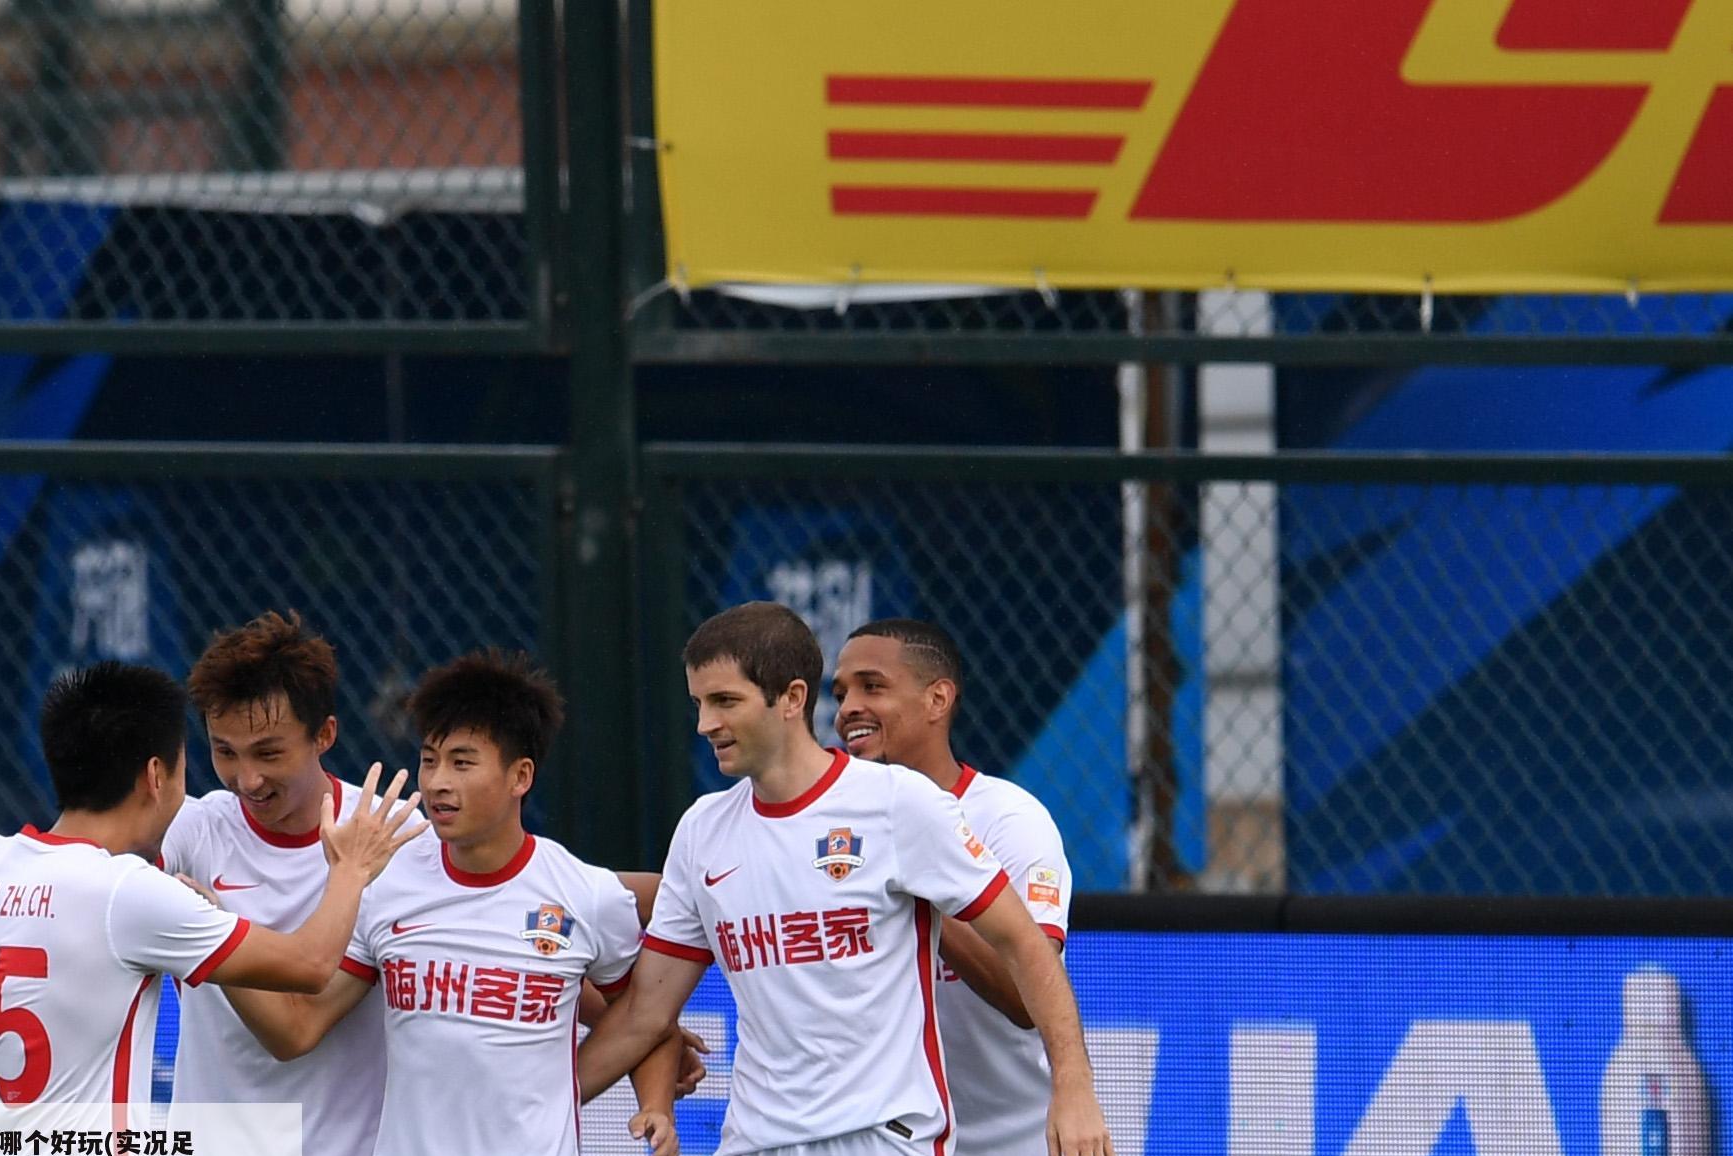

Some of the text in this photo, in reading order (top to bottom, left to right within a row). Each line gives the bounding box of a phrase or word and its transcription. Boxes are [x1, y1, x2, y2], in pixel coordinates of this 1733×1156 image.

[0, 885, 55, 919] ZH.CH.
[716, 906, 874, 973] 梅州客家
[383, 958, 566, 1024] 梅州客家
